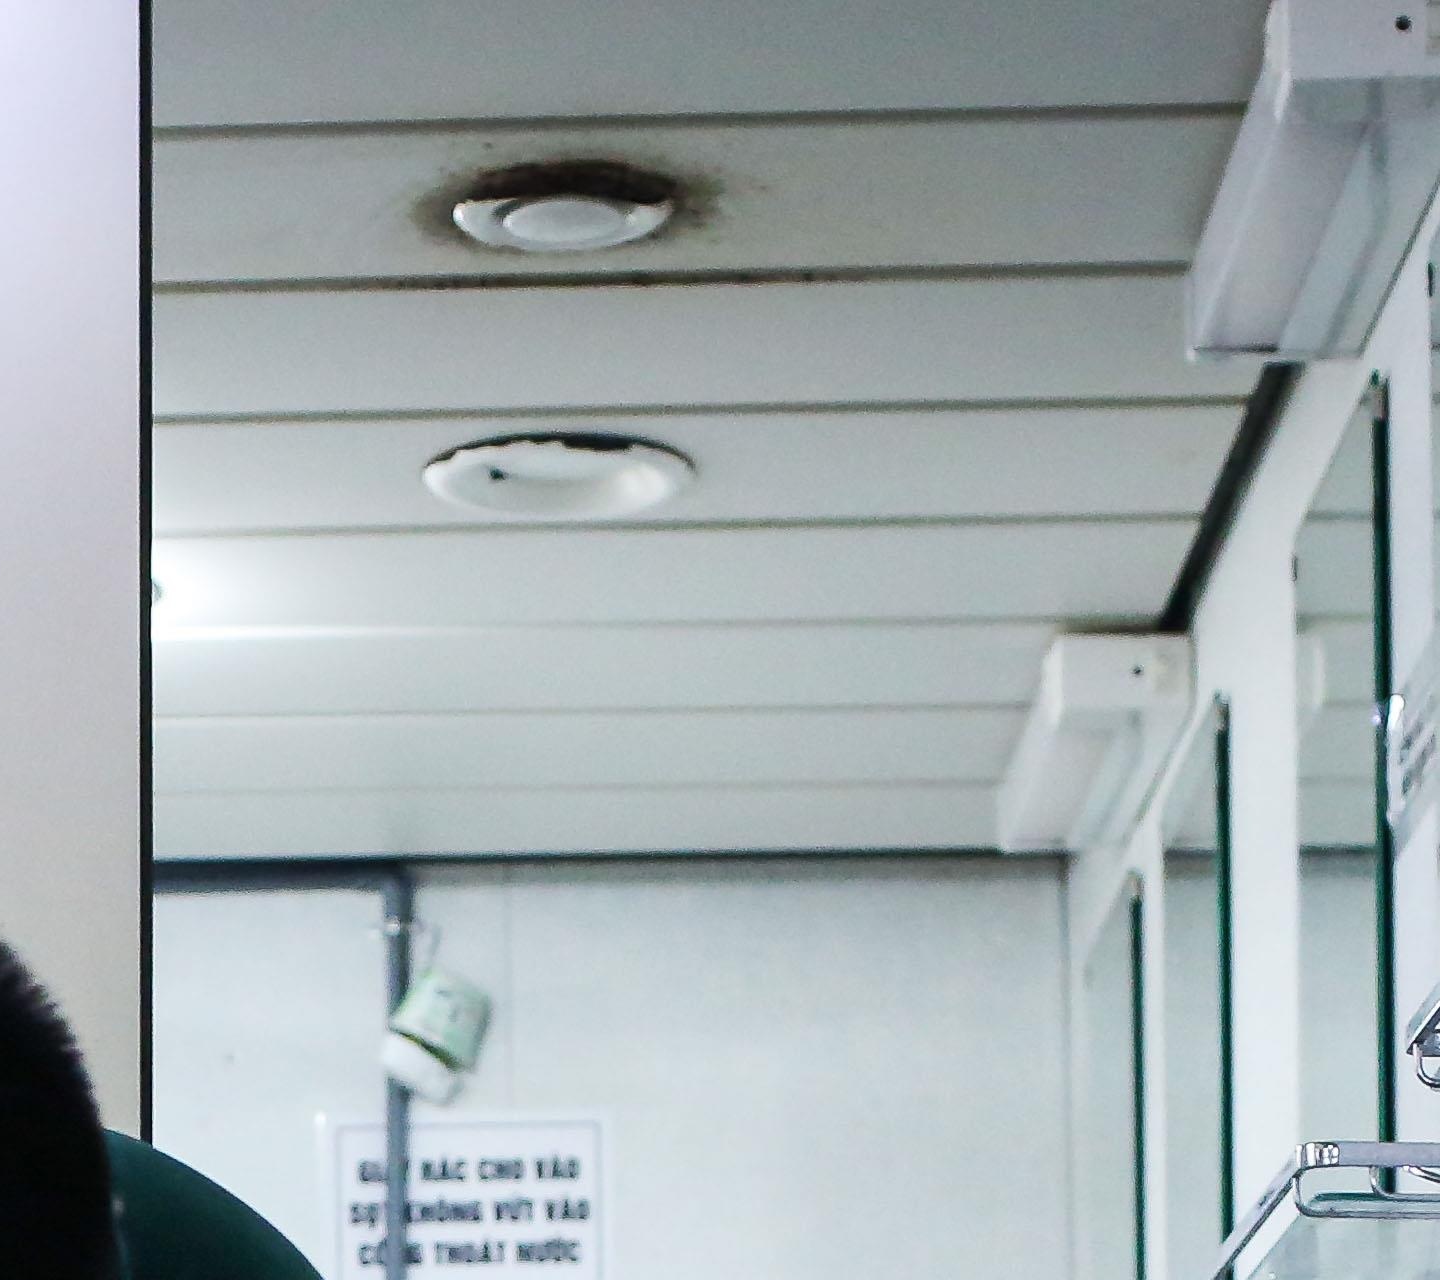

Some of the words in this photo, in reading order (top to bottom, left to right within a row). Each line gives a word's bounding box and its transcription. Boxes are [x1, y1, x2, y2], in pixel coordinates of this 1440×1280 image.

[358, 1157, 410, 1183] GI
[477, 1156, 525, 1181] CHO
[350, 1200, 390, 1228] SỌ
[358, 1237, 423, 1265] CỐG
